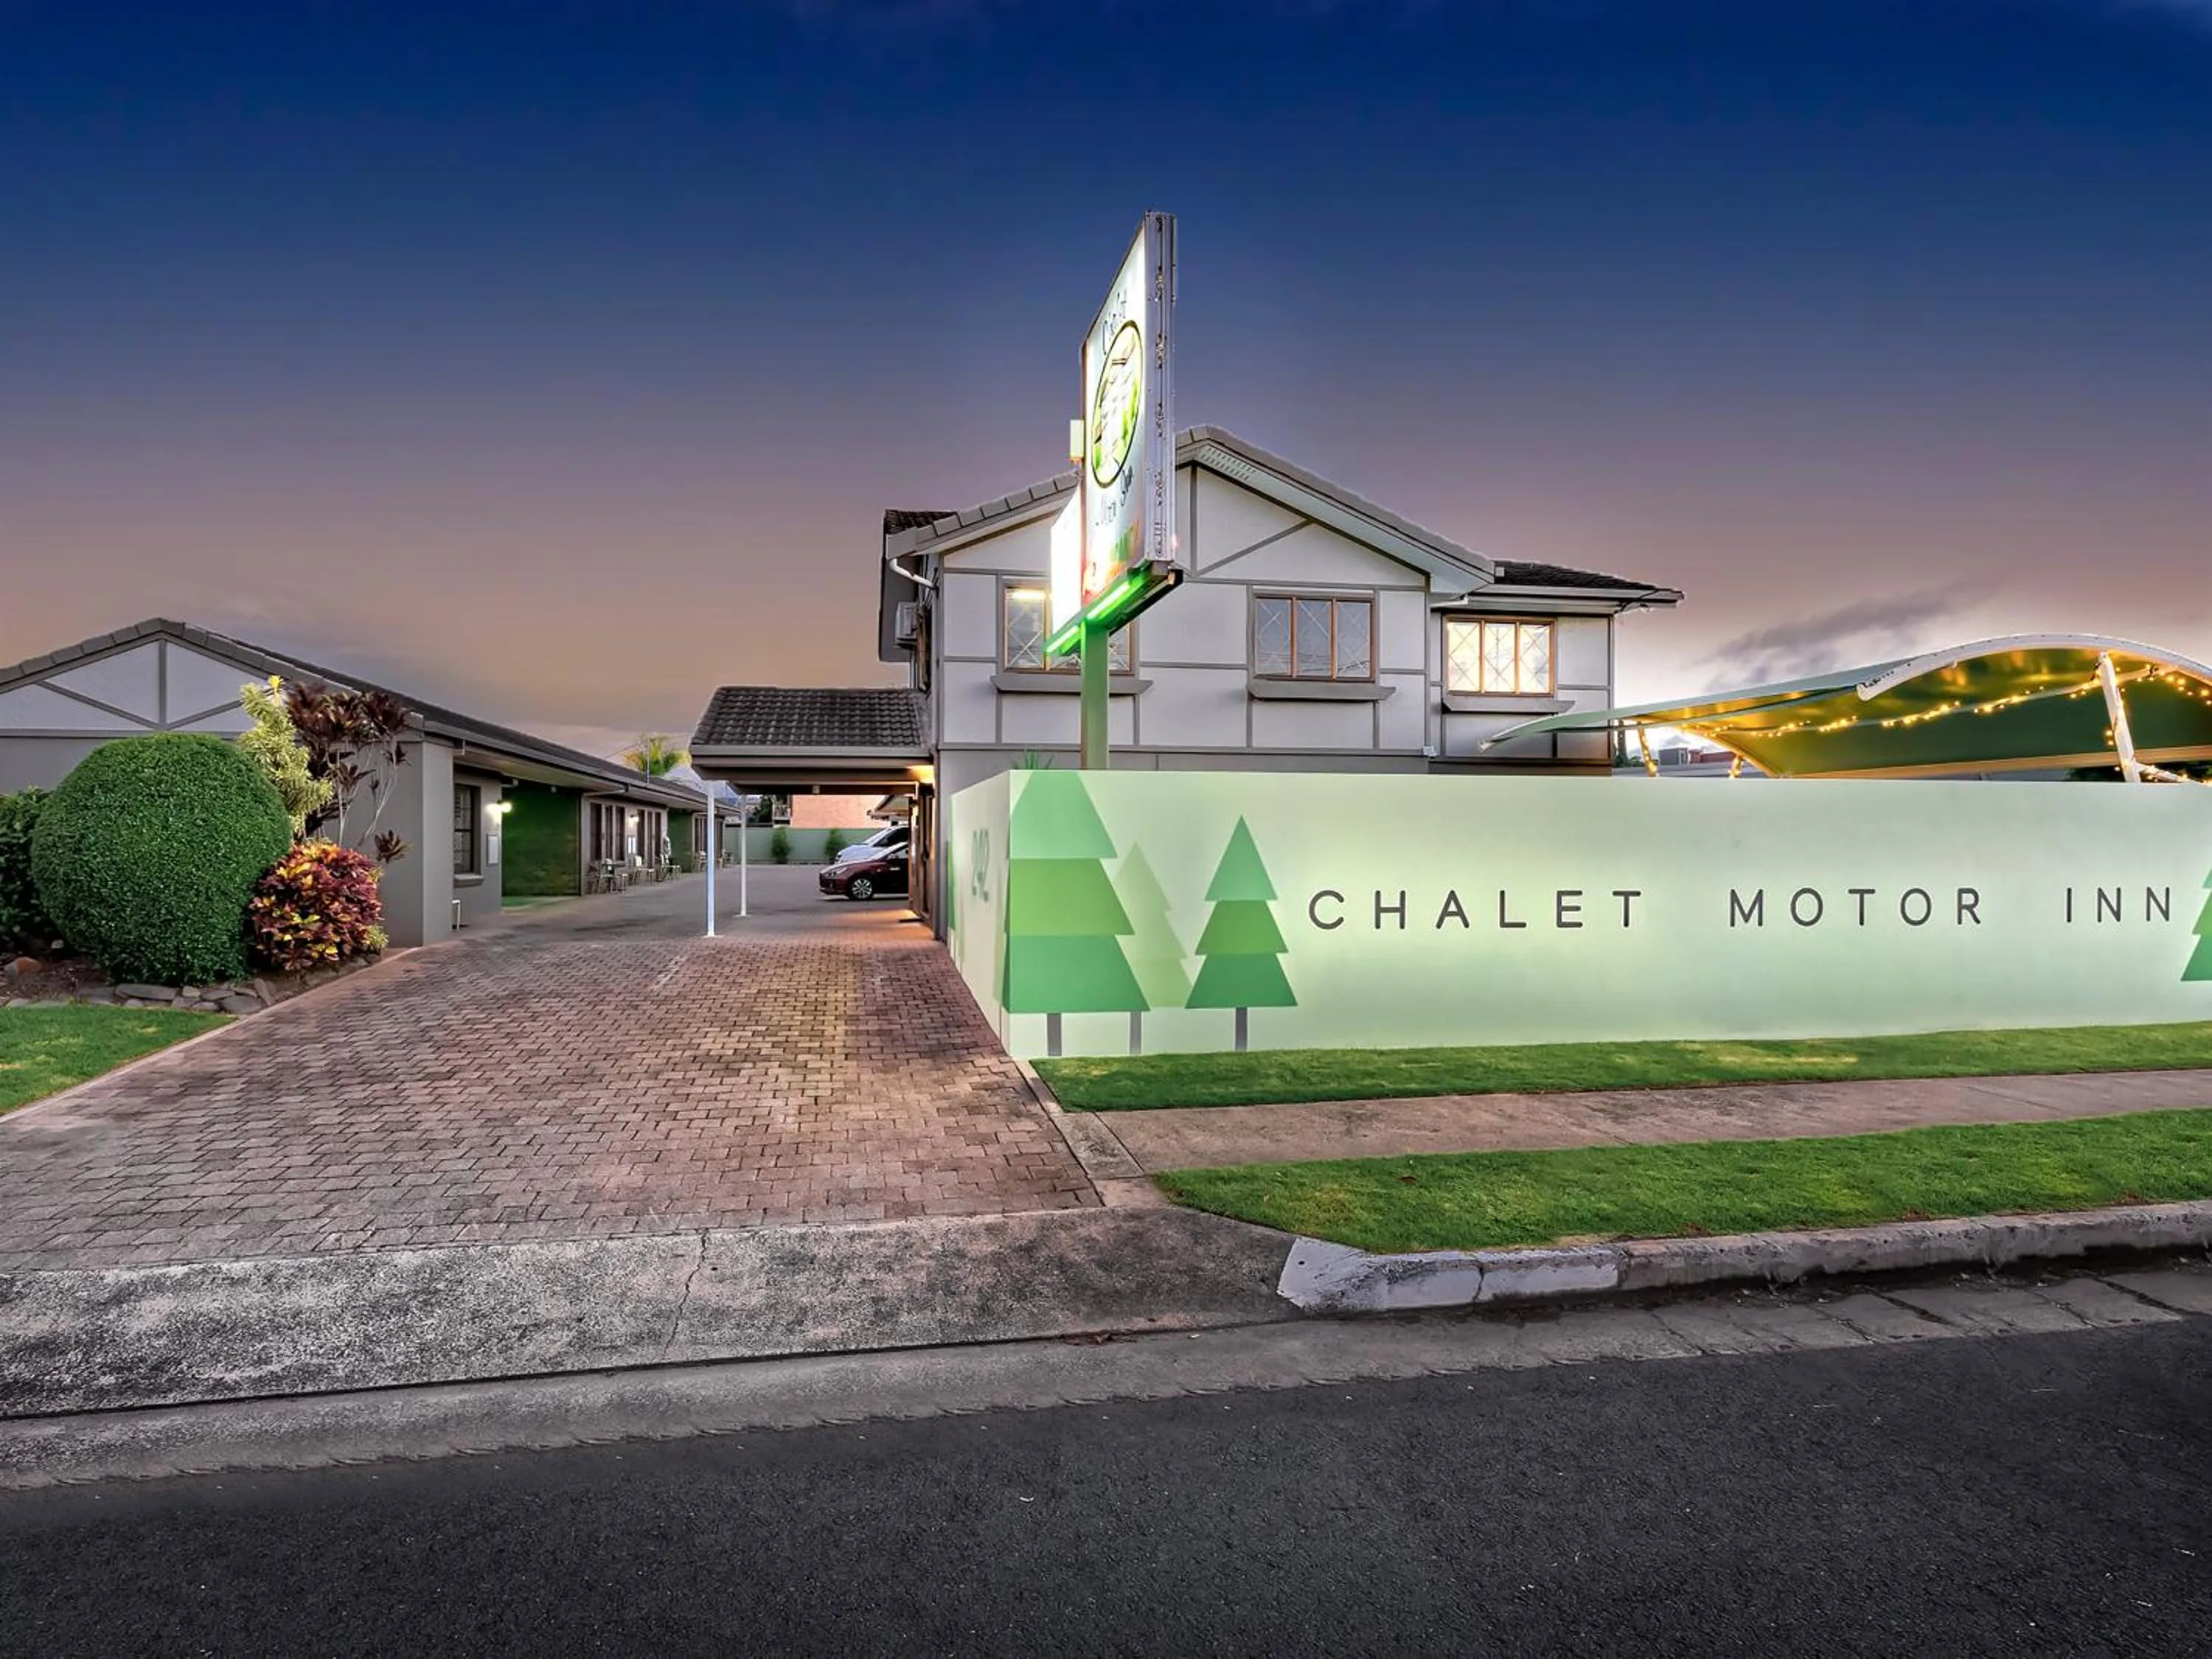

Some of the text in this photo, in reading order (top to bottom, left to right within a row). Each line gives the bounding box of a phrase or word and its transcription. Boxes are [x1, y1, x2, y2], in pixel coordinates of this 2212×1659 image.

[1309, 886, 2172, 930] CHALET MOTOR INN
